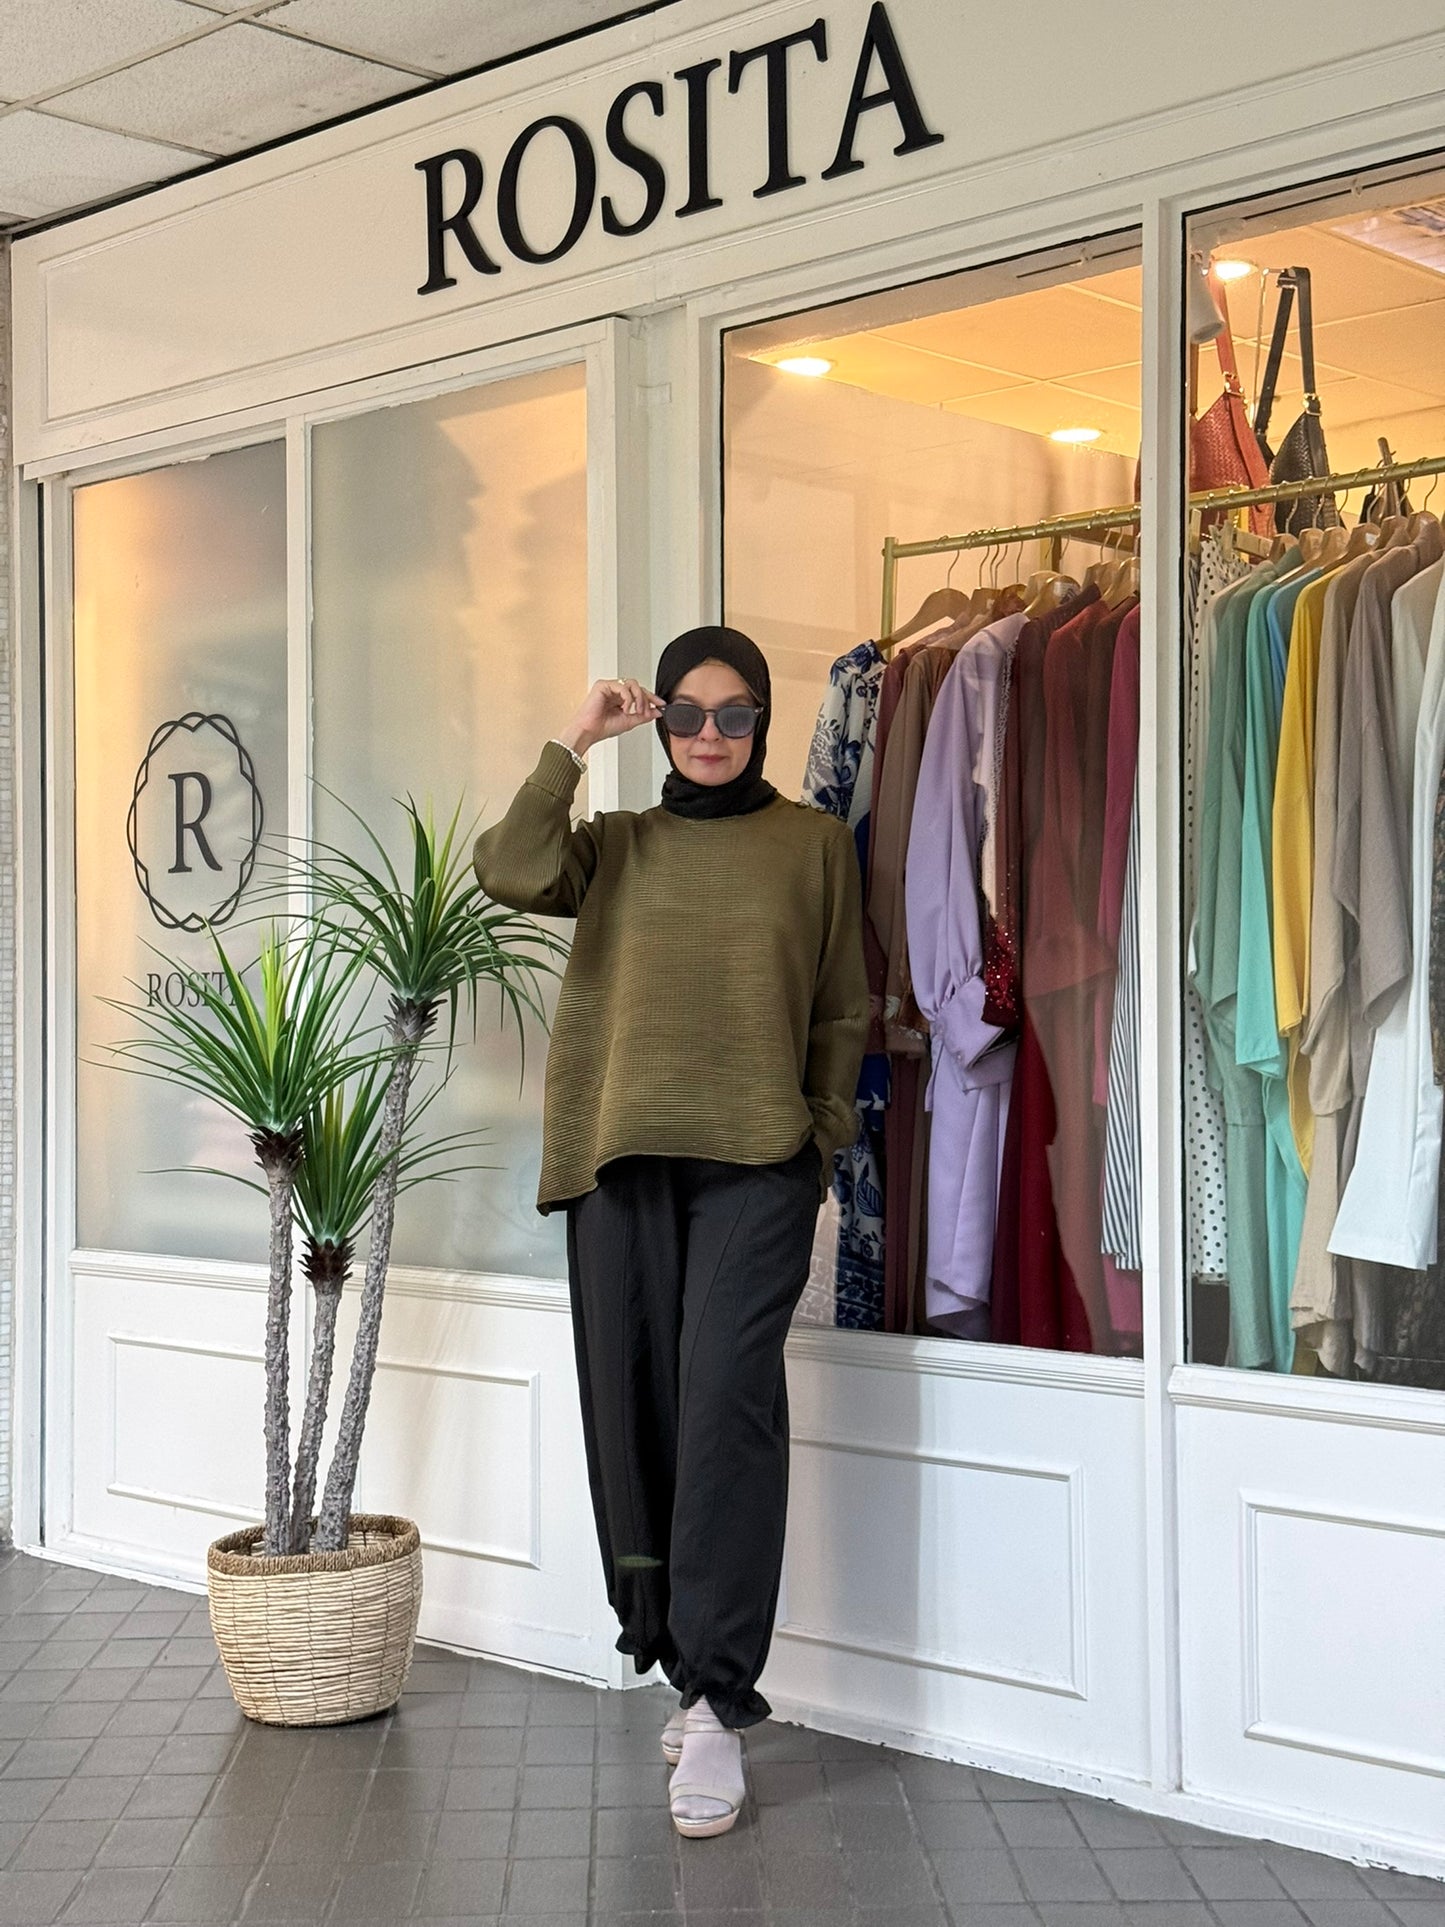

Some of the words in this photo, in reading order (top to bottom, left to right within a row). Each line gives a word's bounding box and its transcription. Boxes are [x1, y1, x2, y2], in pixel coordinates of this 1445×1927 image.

[415, 1, 944, 295] ROSITA
[167, 771, 223, 873] R
[147, 971, 245, 1008] ROSIT
